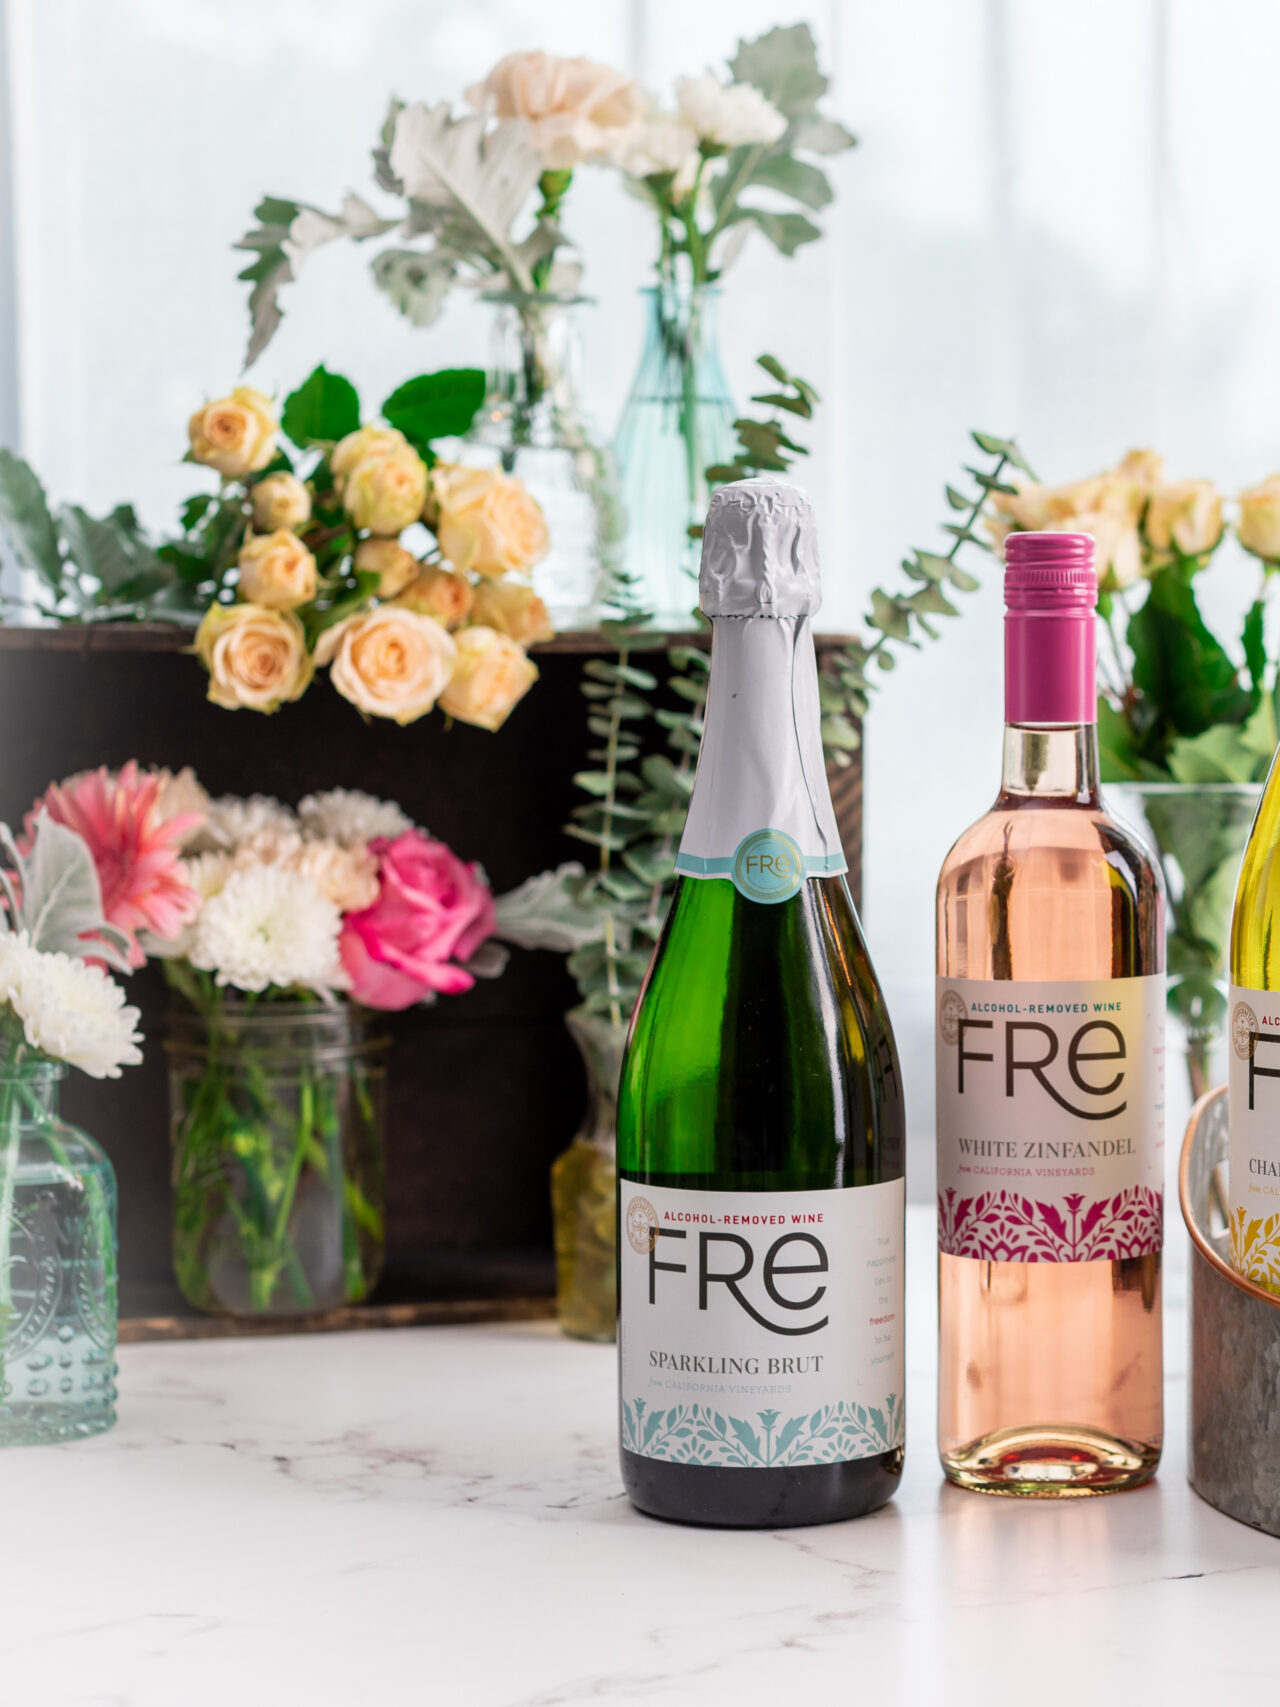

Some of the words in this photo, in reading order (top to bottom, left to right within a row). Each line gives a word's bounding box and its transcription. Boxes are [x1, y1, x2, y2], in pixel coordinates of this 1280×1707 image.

[971, 1002, 1088, 1014] ALCOHOL-REMOVED
[1093, 1002, 1122, 1012] WINE
[958, 1137, 1017, 1158] WHITE
[1024, 1138, 1136, 1159] ZINFANDEL
[973, 1165, 1032, 1177] CALIFORNIA
[1035, 1167, 1096, 1177] VINEYARDS
[664, 1211, 785, 1225] ALCOHOL-REMOVED
[791, 1213, 824, 1224] WINE
[869, 1313, 896, 1326] freedom
[649, 1351, 759, 1375] SPARKLING
[768, 1355, 824, 1375] BRUT
[665, 1379, 725, 1393] CALIFORNIA
[728, 1384, 792, 1394] VINEYARDS
